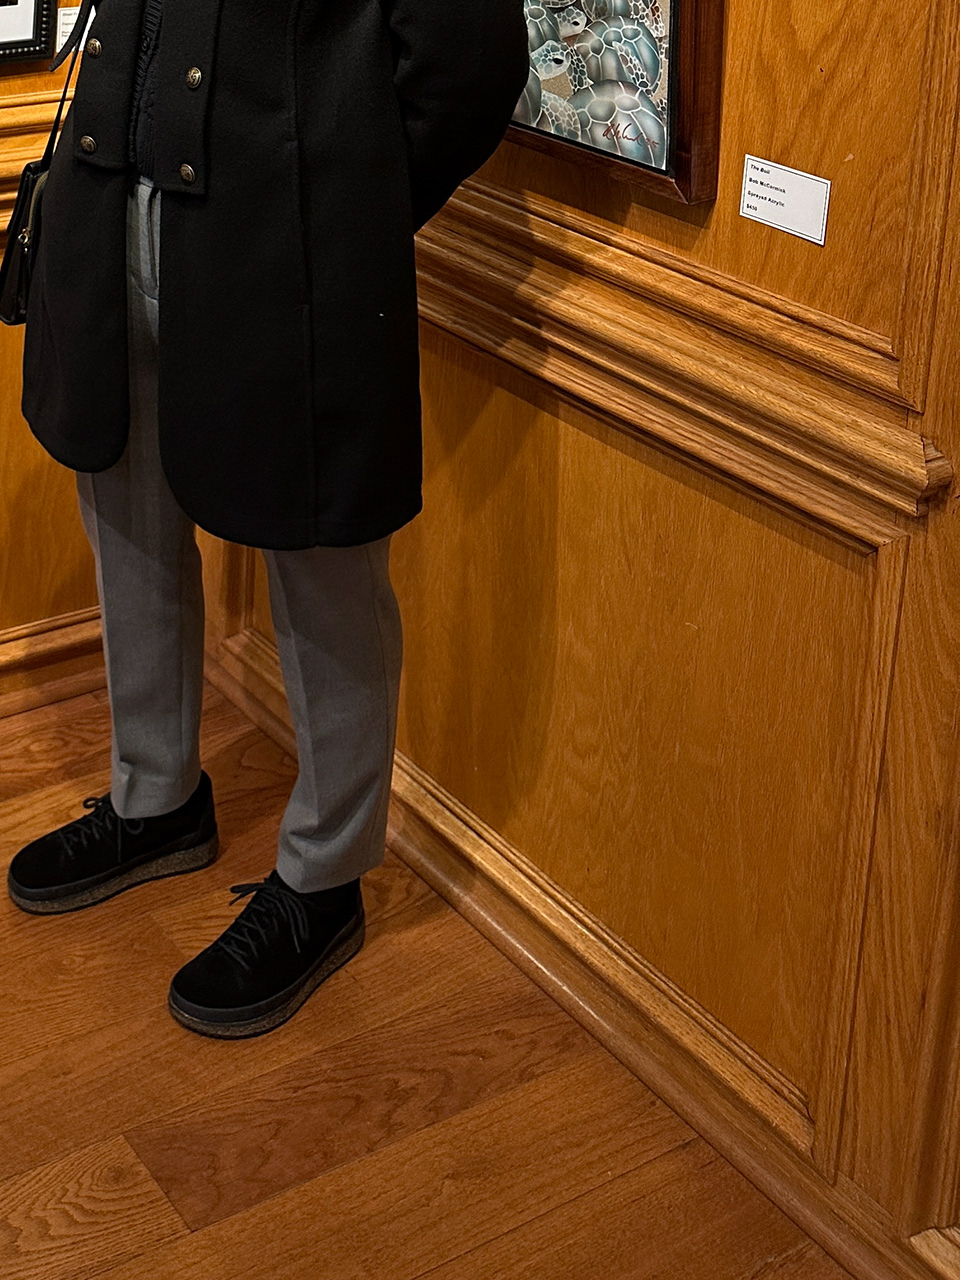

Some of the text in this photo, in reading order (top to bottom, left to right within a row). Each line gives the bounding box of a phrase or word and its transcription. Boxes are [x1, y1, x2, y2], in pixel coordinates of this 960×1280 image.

[750, 164, 759, 172] The
[749, 177, 786, 194] Bob McCormick
[747, 190, 785, 208] Sprayed Acrylic
